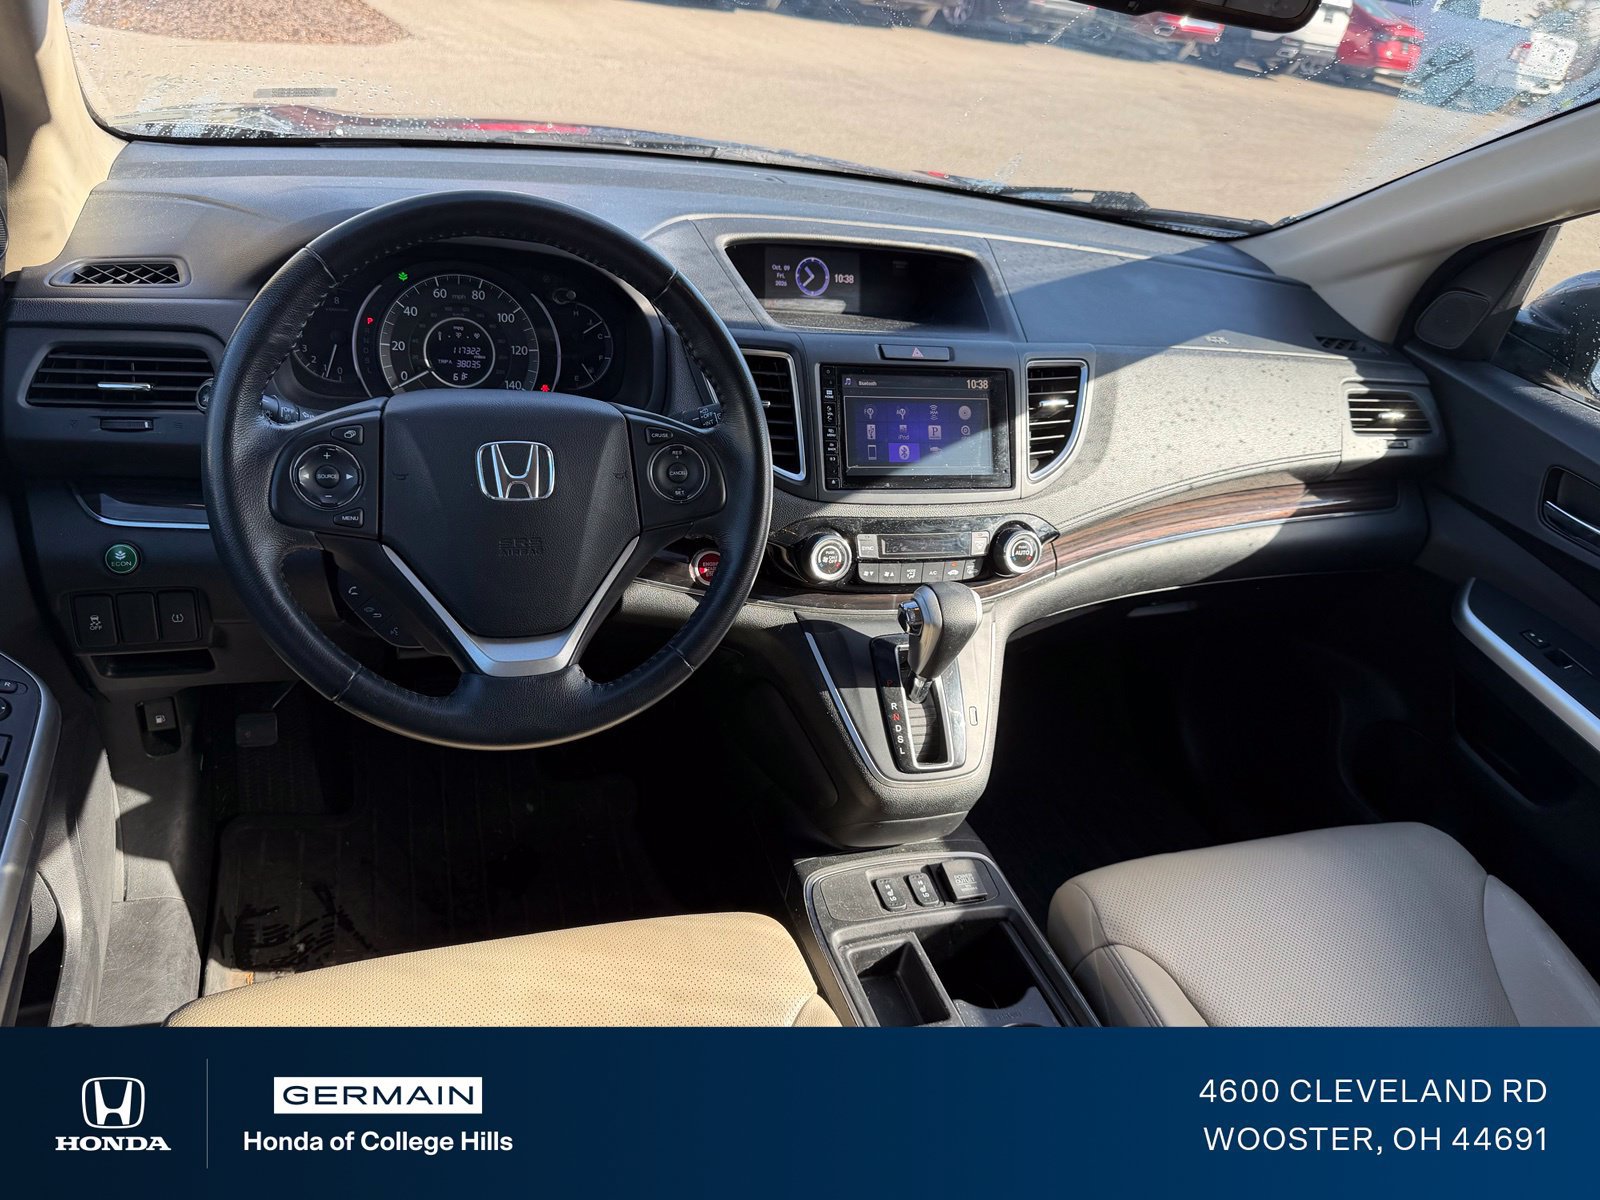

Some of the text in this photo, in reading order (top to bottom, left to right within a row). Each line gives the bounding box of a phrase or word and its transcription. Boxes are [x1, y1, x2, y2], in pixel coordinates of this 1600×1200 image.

[834, 274, 854, 284] 10:38
[433, 288, 448, 298] 60
[472, 290, 486, 300] 80
[404, 306, 418, 316] 40
[497, 312, 515, 322] 100
[392, 340, 406, 351] 20
[454, 346, 481, 355] 117322
[510, 346, 528, 356] 120
[400, 370, 408, 380] 0
[504, 380, 522, 390] 140
[966, 379, 988, 389] 10:38
[890, 702, 898, 710] R
[895, 724, 902, 732] D
[896, 735, 904, 744] S
